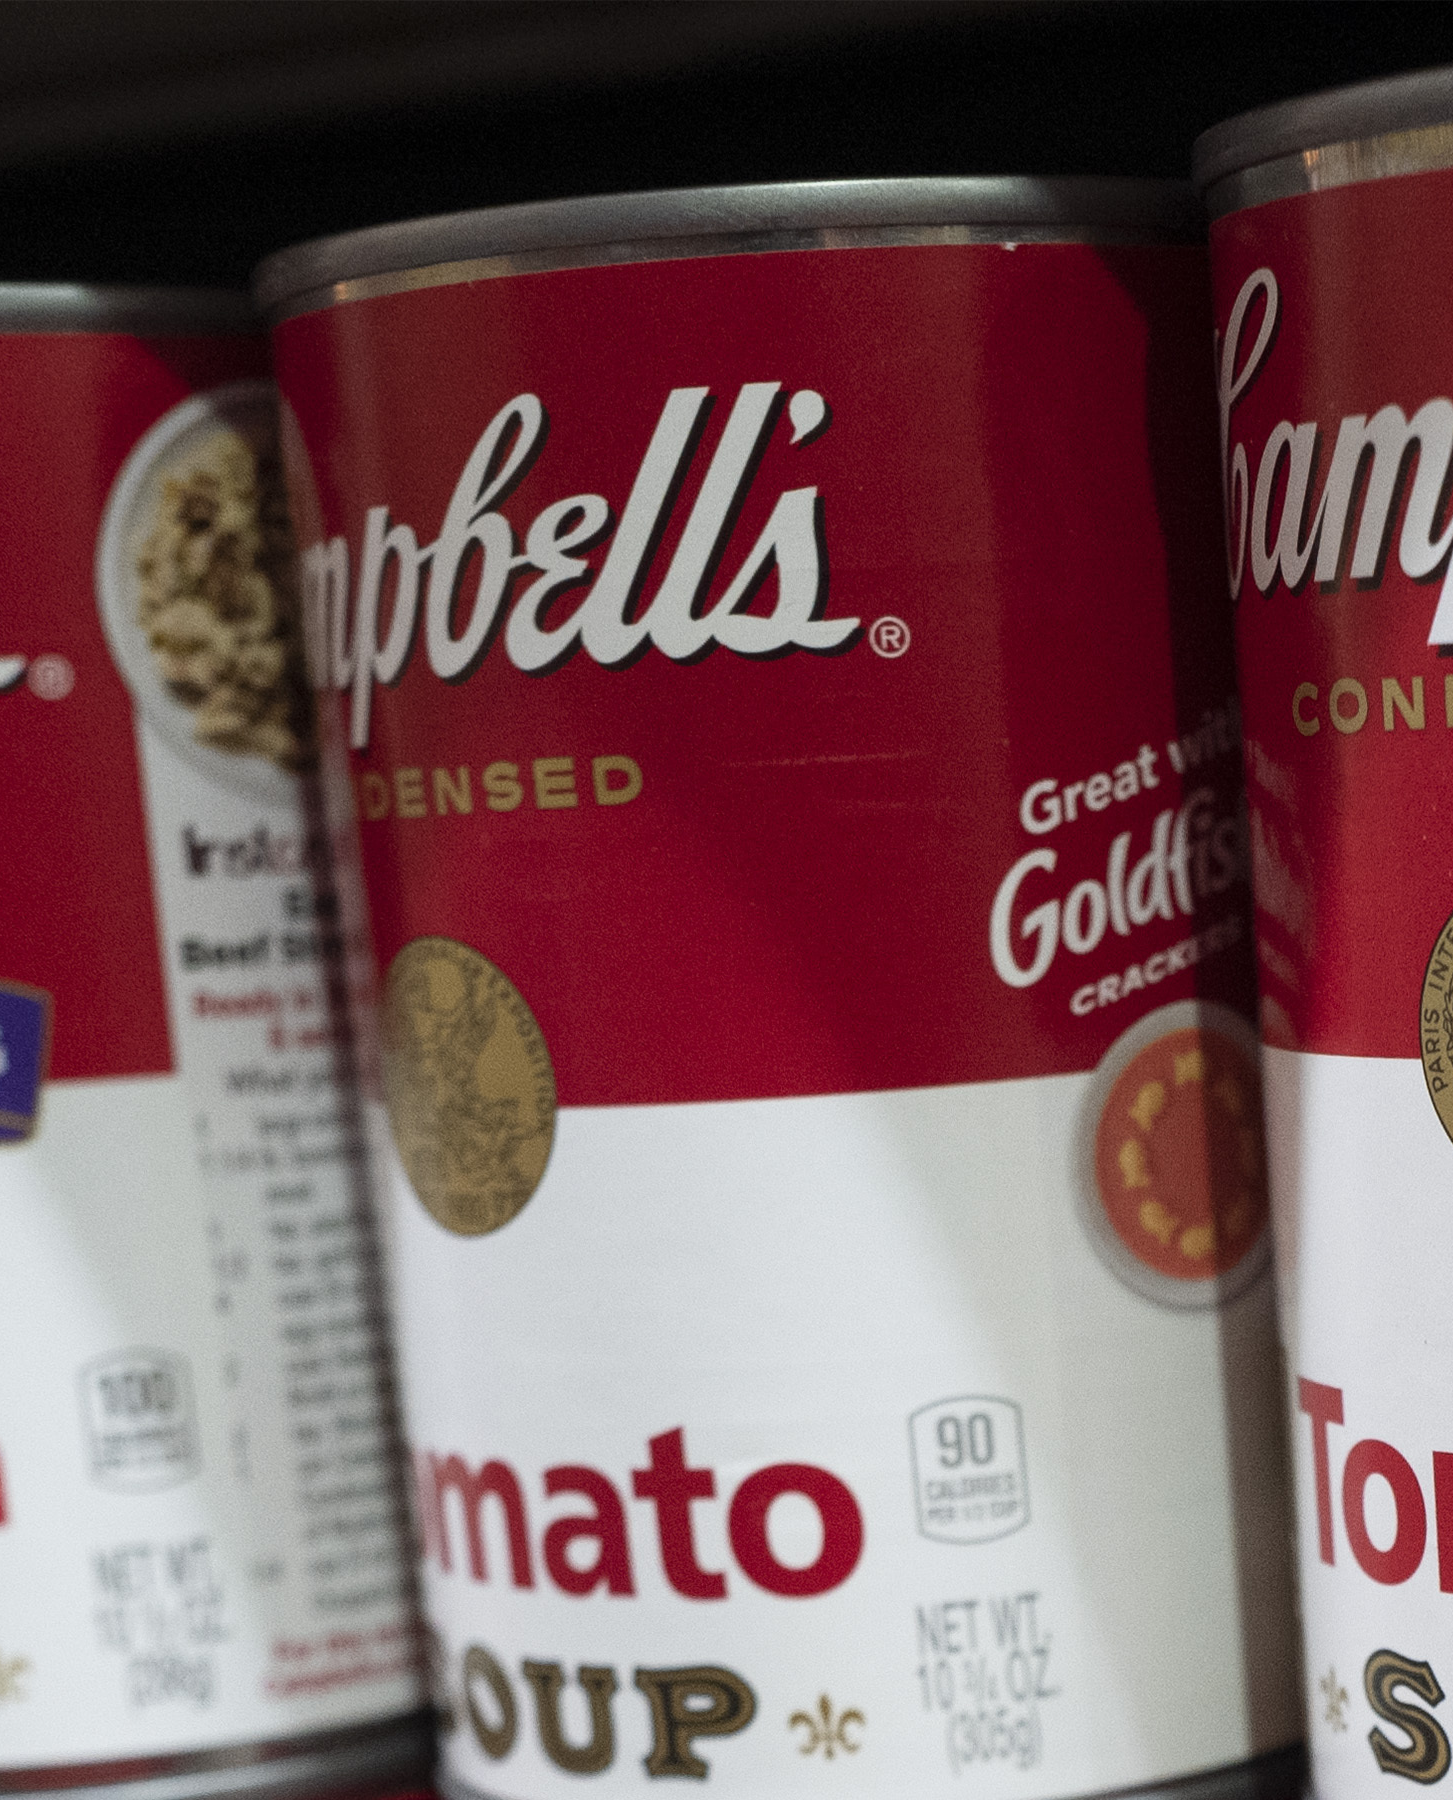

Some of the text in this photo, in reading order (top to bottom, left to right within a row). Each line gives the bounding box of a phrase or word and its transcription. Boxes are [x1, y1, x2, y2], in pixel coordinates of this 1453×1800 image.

[1019, 744, 1160, 836] Great
[1423, 1007, 1449, 1093] PARIS
[936, 1412, 994, 1468] 90
[438, 1645, 759, 1782] OUP
